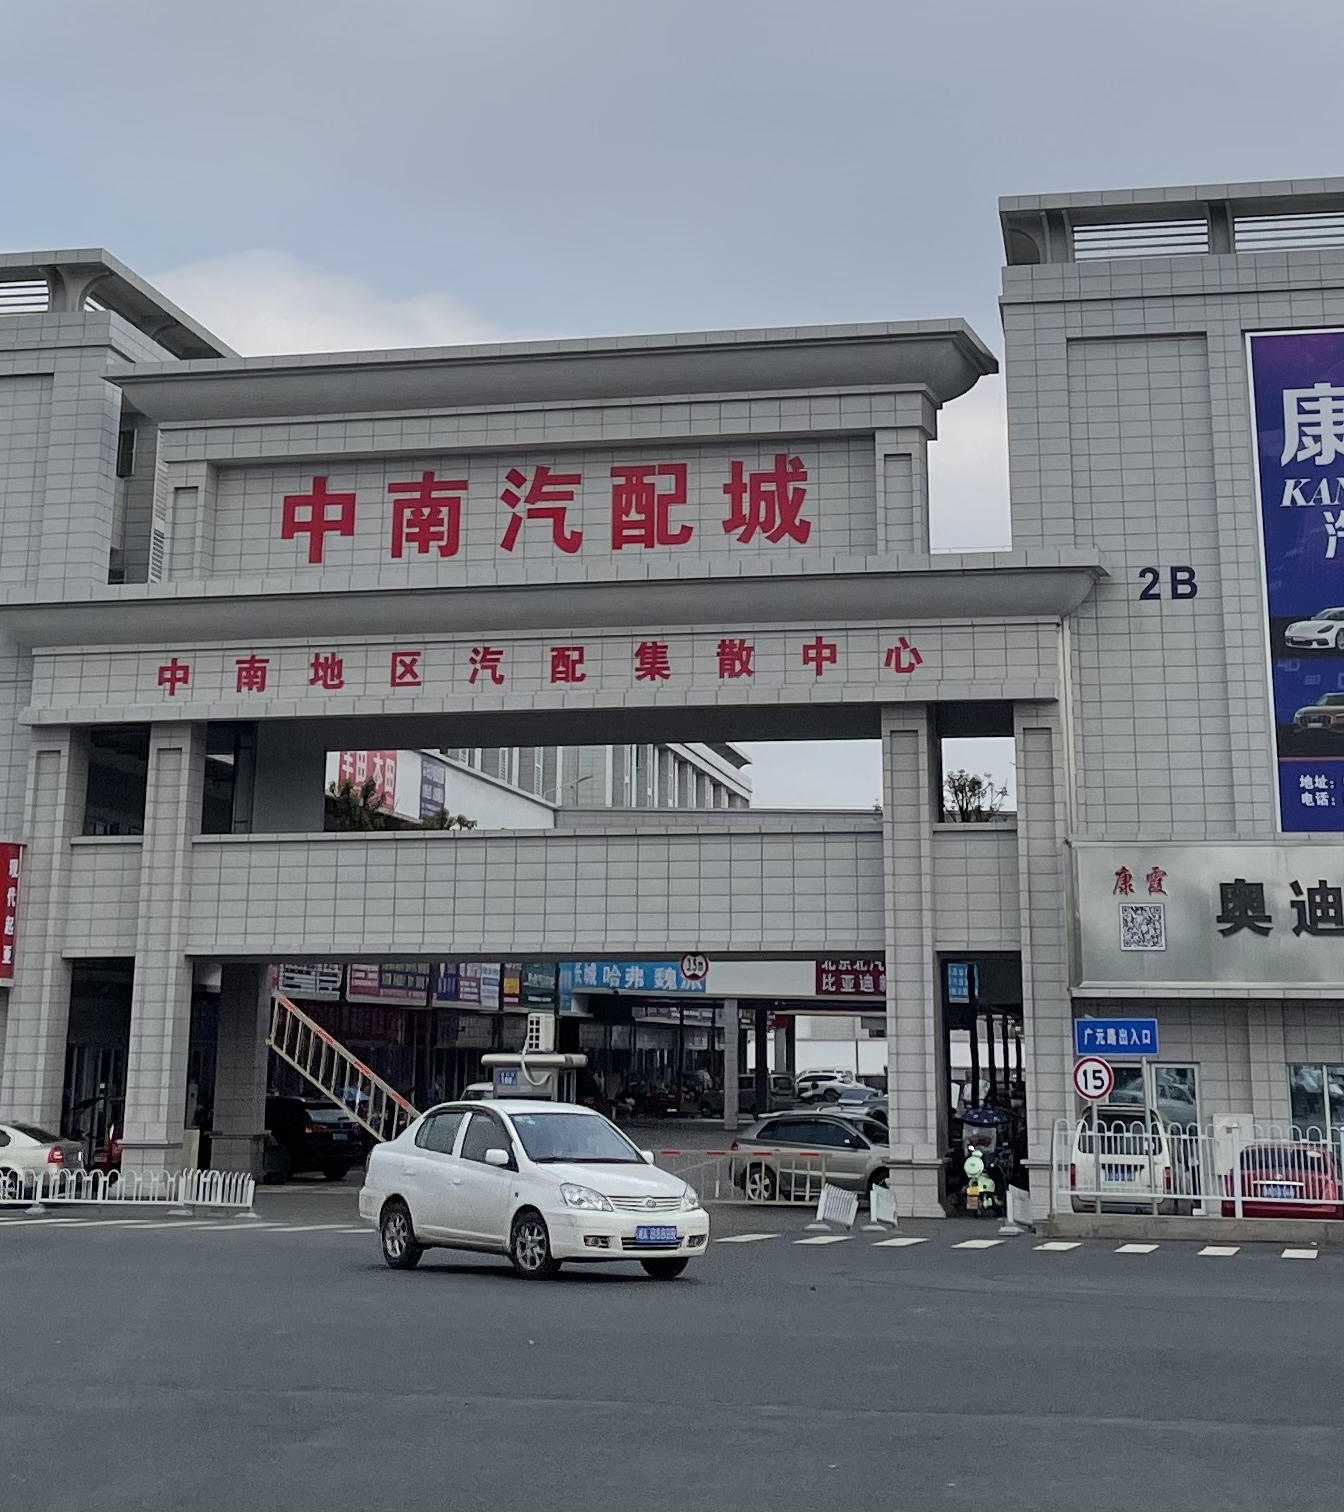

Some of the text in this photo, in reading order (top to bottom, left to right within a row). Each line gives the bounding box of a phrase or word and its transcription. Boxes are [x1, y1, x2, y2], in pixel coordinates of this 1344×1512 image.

[280, 453, 812, 565] 中南汽配城
[1137, 565, 1199, 601] 2B
[157, 635, 923, 697] 中南地区汽配集散中心
[1082, 1069, 1105, 1090] 15
